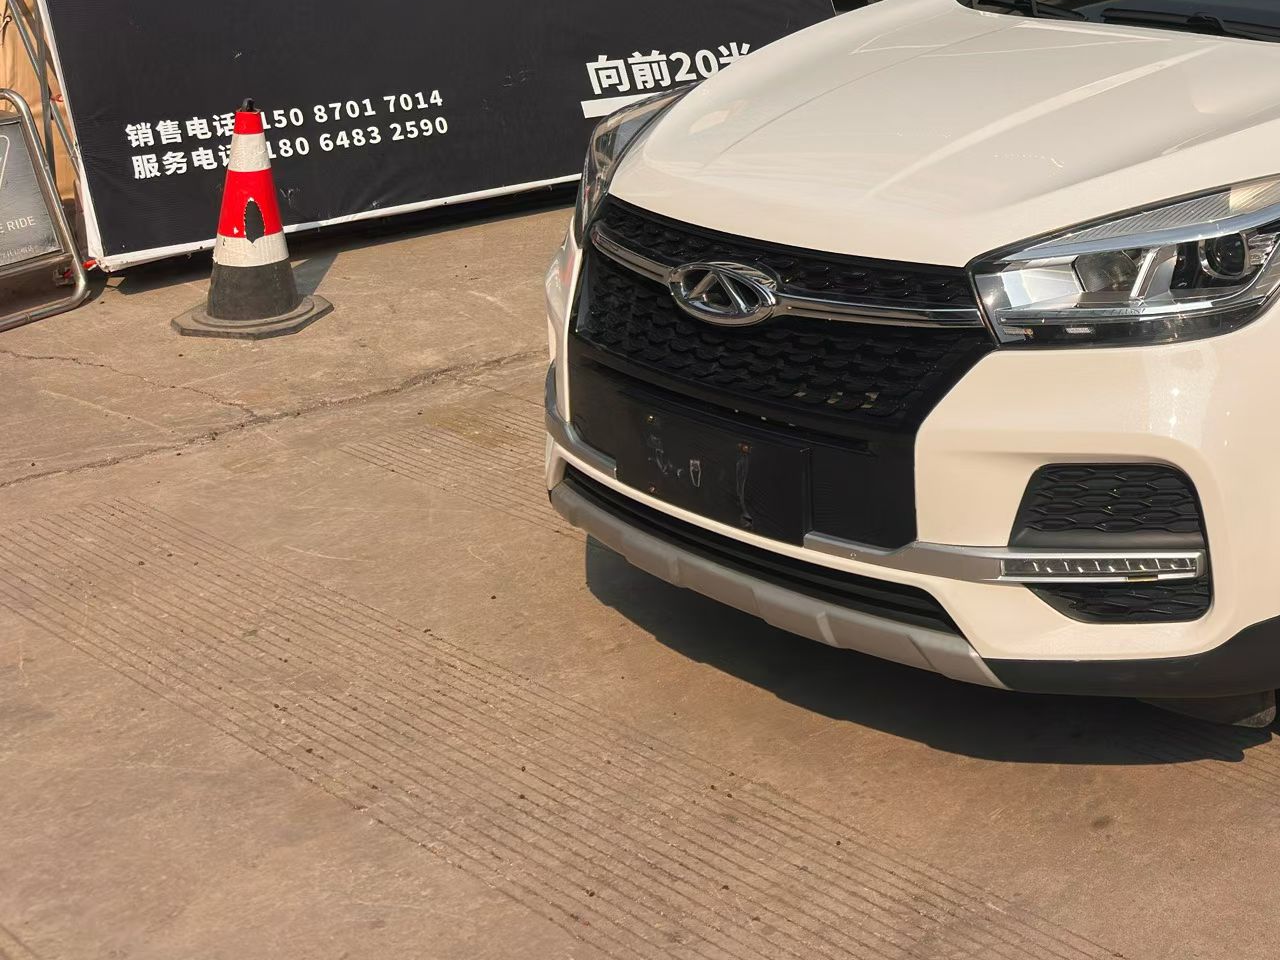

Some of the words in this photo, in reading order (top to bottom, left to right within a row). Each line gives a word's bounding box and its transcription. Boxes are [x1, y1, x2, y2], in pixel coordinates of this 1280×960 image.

[260, 108, 304, 130] 150
[313, 98, 376, 123] 8701
[383, 90, 443, 113] 7014
[266, 137, 310, 159] 180
[319, 126, 382, 151] 6483
[389, 117, 449, 141] 2590
[6, 216, 36, 231] RIDE
